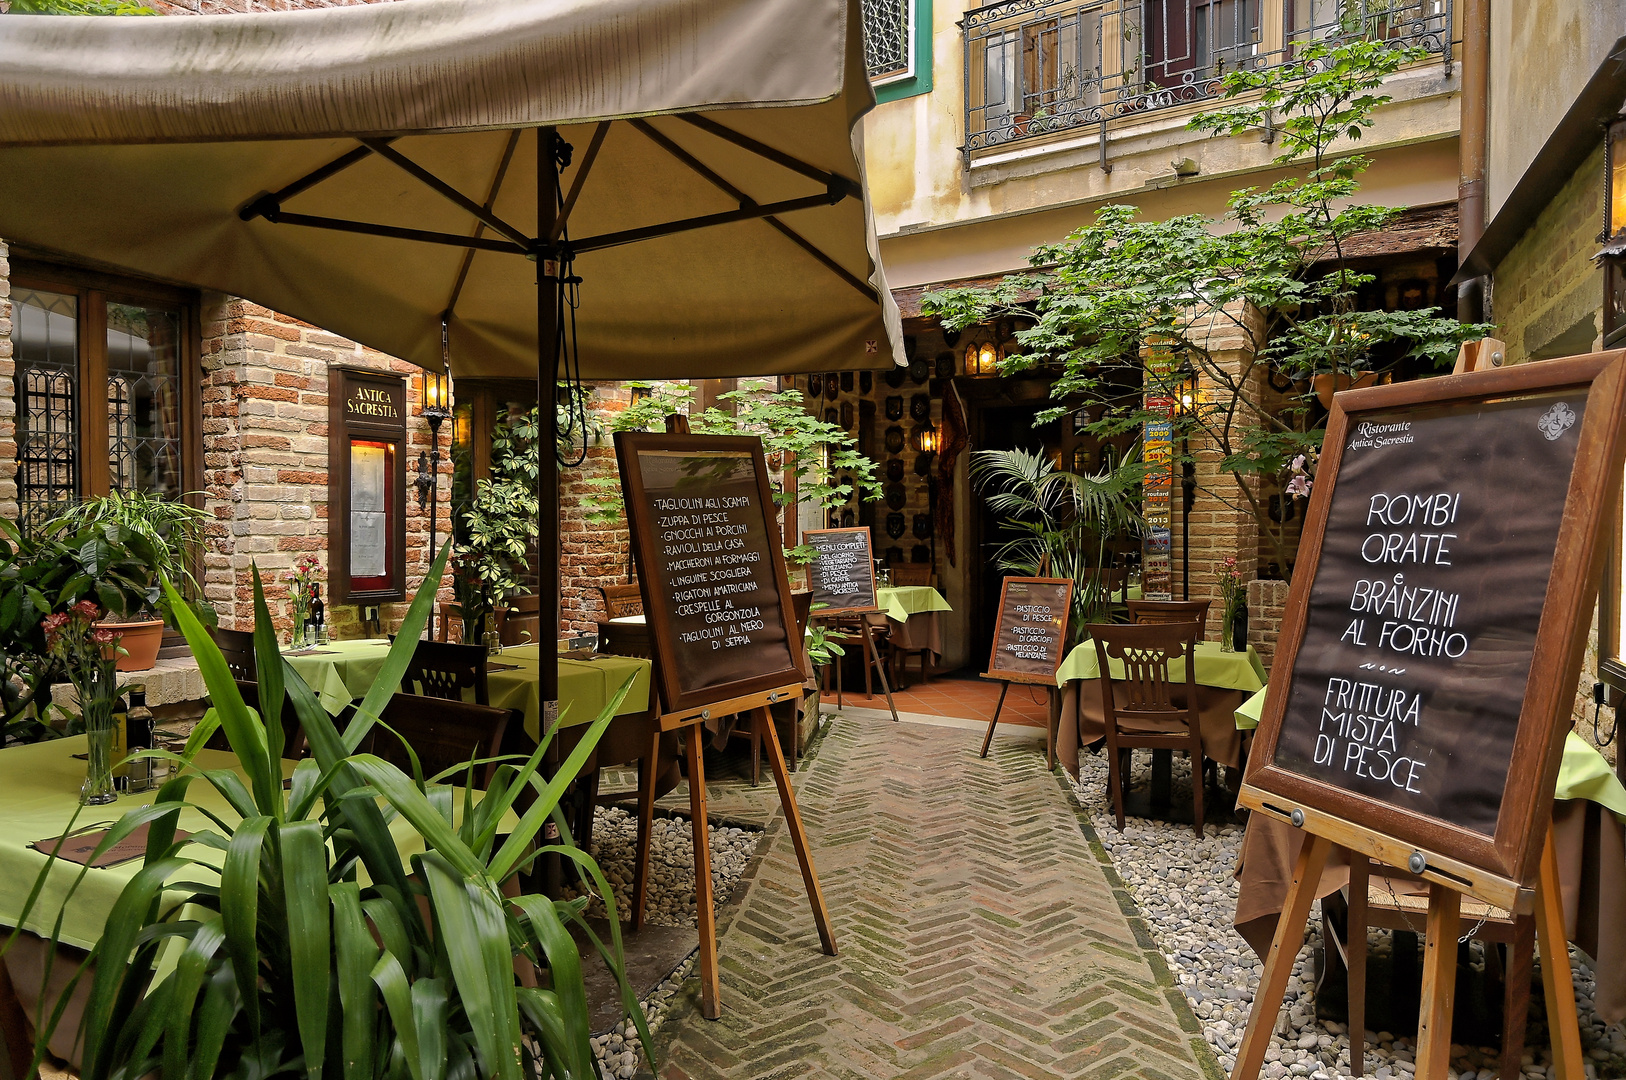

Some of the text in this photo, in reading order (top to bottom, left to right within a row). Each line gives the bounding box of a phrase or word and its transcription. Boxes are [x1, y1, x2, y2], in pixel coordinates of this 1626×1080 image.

[355, 387, 392, 403] ANTICA
[347, 398, 398, 418] SACRESTIA
[1357, 420, 1411, 438] Ristorante
[1346, 433, 1414, 450] Antica Sacrestia
[655, 496, 750, 511] TAGLIOLINI AGLI SCAMPI
[1366, 492, 1460, 526] ROMBI
[660, 512, 729, 528] ZUPPA DI PESCE
[663, 524, 748, 542] GNOCCHI AI PORCINI
[665, 538, 745, 556] RAVIOLI DELLA CASA
[831, 552, 855, 560] GIORNO
[1361, 533, 1457, 565] ORATE
[668, 552, 760, 571] MACCHERONI AI FORMAGGI
[671, 566, 752, 587] LINGUINE SCOGLIERA
[1393, 572, 1404, 585] e
[674, 581, 759, 603] RIGATONI AMATRICIANA
[677, 599, 735, 617] CRESPELLE AL
[1016, 604, 1051, 613] PASTICCIO
[1350, 579, 1459, 628] BRANZINI
[705, 607, 761, 624] GORGONZOLA
[1032, 614, 1052, 622] PESCE
[681, 620, 764, 643] TAGLIOLINI AL NERO
[1012, 626, 1046, 635] PASTICCIO
[1026, 635, 1052, 643] CARCIOFI
[1340, 618, 1468, 658] AL FORNO
[711, 635, 751, 650] DI SEPPIA
[1007, 644, 1039, 652] PASTICCIO
[1015, 651, 1047, 660] MELANZANE
[1324, 677, 1420, 726] FRITTURA
[1319, 707, 1396, 752] MISTA
[1313, 734, 1426, 794] DI PESCE
